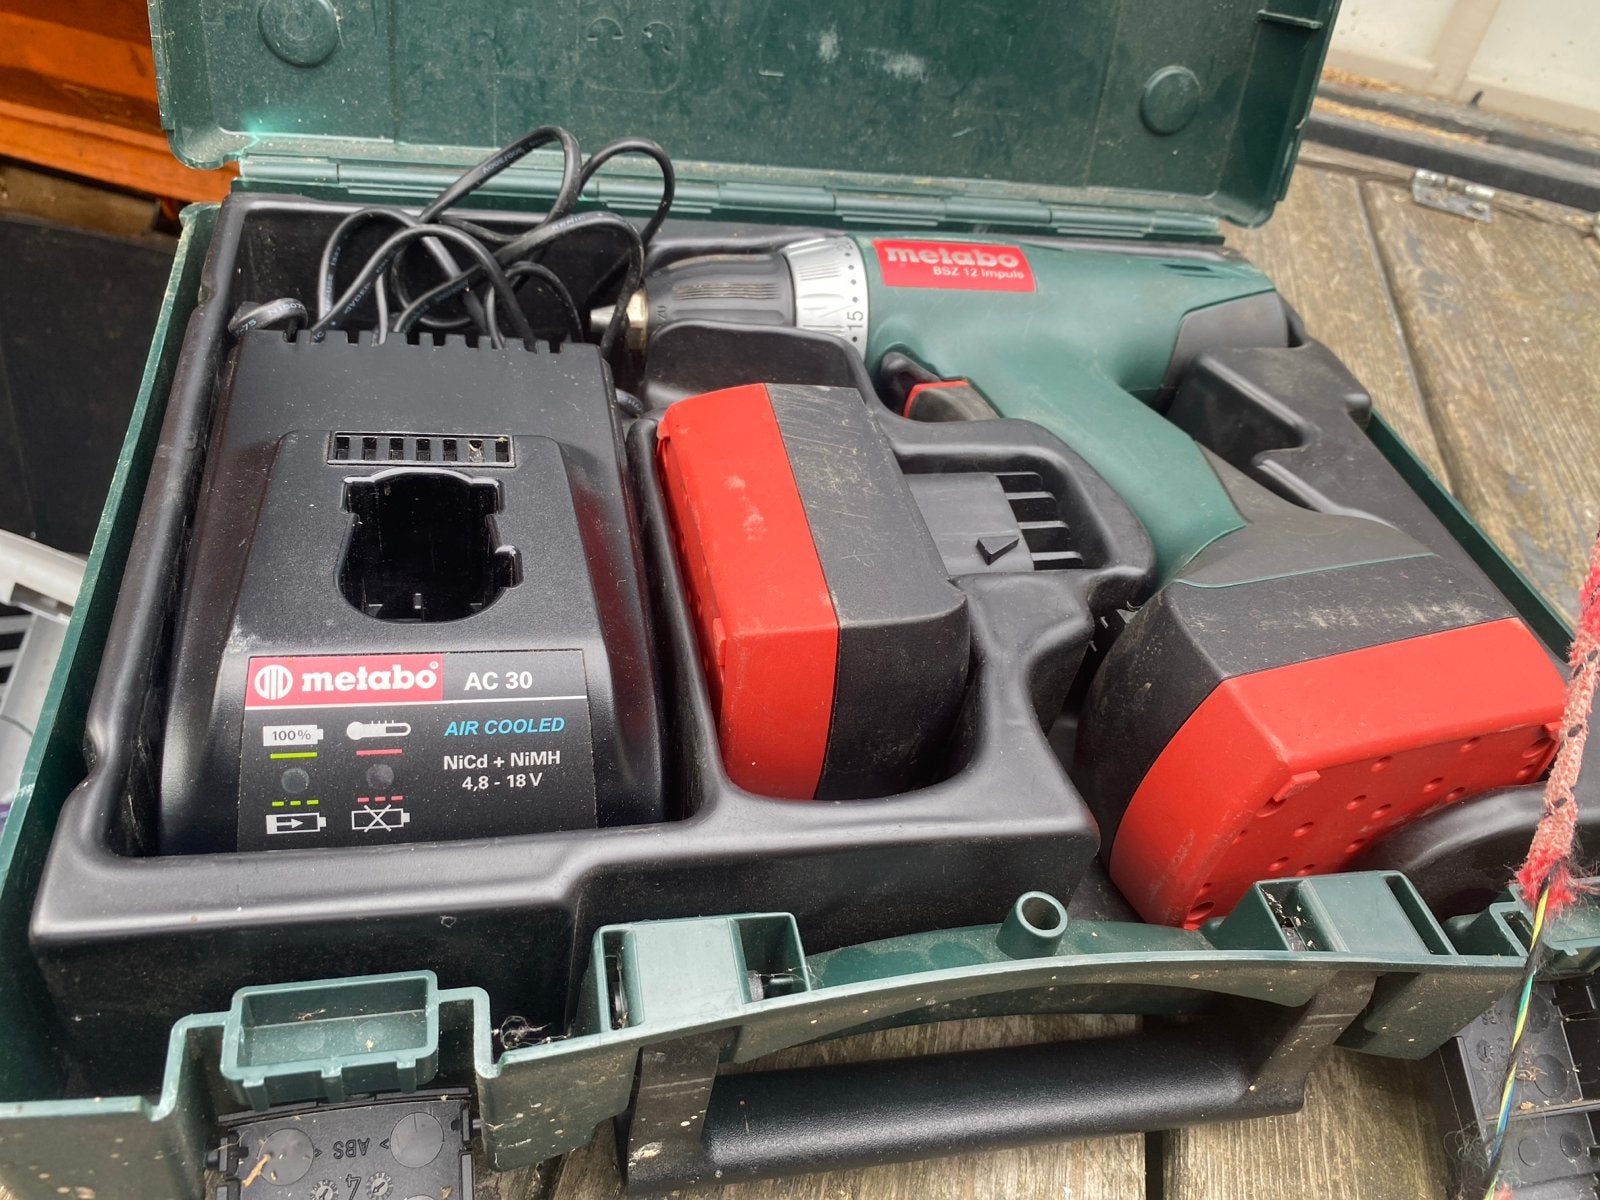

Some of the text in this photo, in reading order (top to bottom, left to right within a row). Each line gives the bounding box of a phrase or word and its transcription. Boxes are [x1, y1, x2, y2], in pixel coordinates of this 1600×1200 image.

[884, 246, 1020, 269] metabo
[932, 265, 960, 277] BSZ
[963, 267, 978, 278] 12
[846, 310, 864, 331] 15
[463, 671, 499, 691] AC
[505, 670, 533, 690] 30
[271, 729, 312, 742] 100%
[444, 716, 566, 737] AIR COOLED
[443, 750, 561, 771] NiCd + NiMH
[462, 775, 489, 792] 4,8
